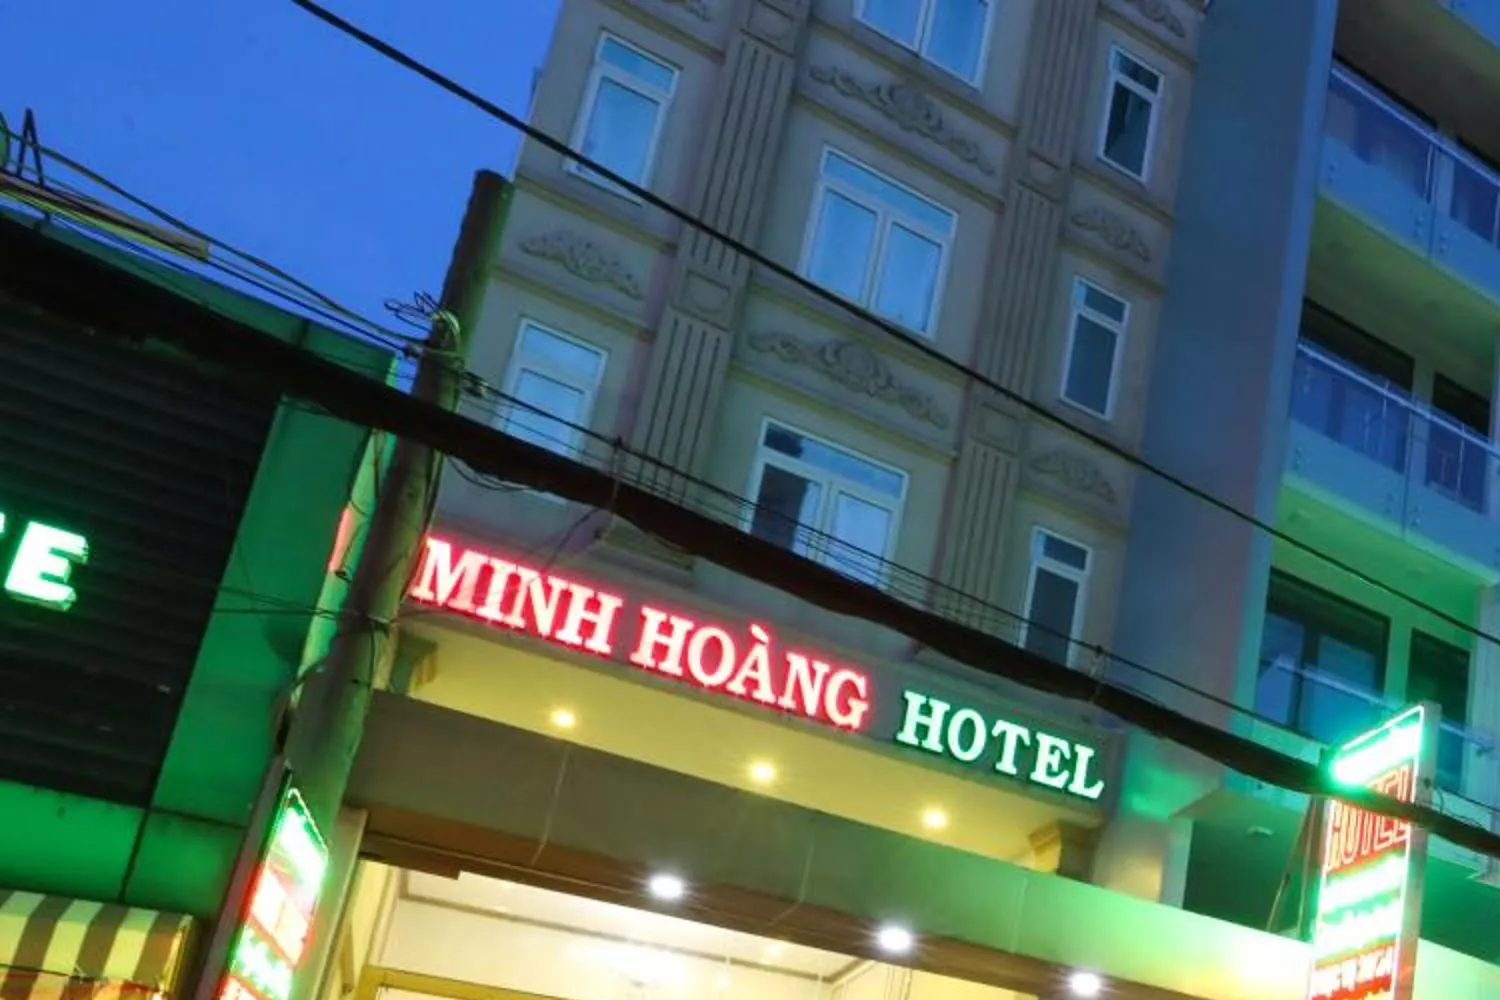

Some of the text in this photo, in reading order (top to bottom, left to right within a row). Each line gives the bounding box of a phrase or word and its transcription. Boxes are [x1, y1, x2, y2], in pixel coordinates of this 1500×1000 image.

[409, 536, 1105, 800] MINH HOÀNG HOTEL
